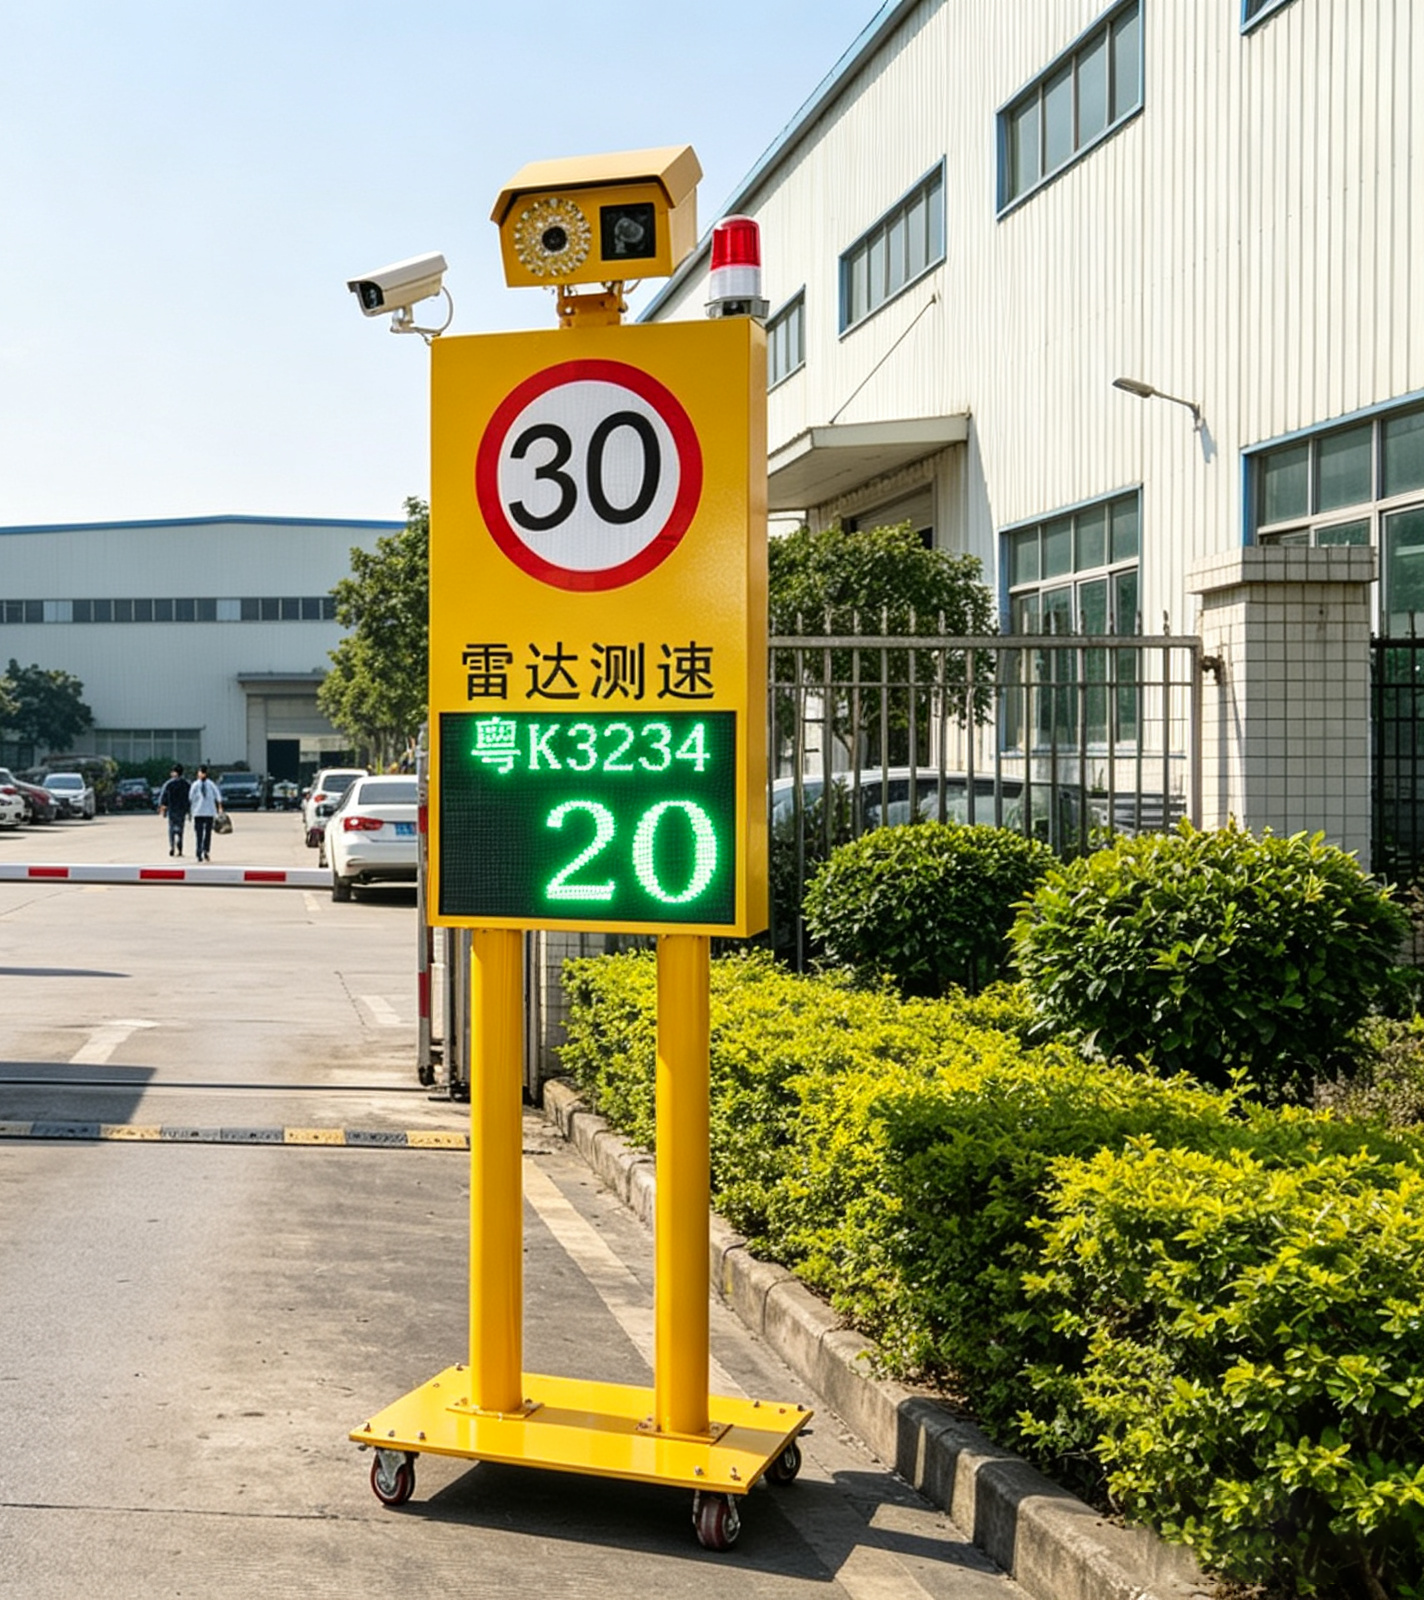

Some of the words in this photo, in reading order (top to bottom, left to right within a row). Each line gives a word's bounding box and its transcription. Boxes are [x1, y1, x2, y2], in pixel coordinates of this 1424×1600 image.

[508, 410, 661, 532] 30
[461, 641, 715, 701] 雷达测速
[470, 716, 711, 775] 粤K3234
[545, 799, 718, 904] 20
